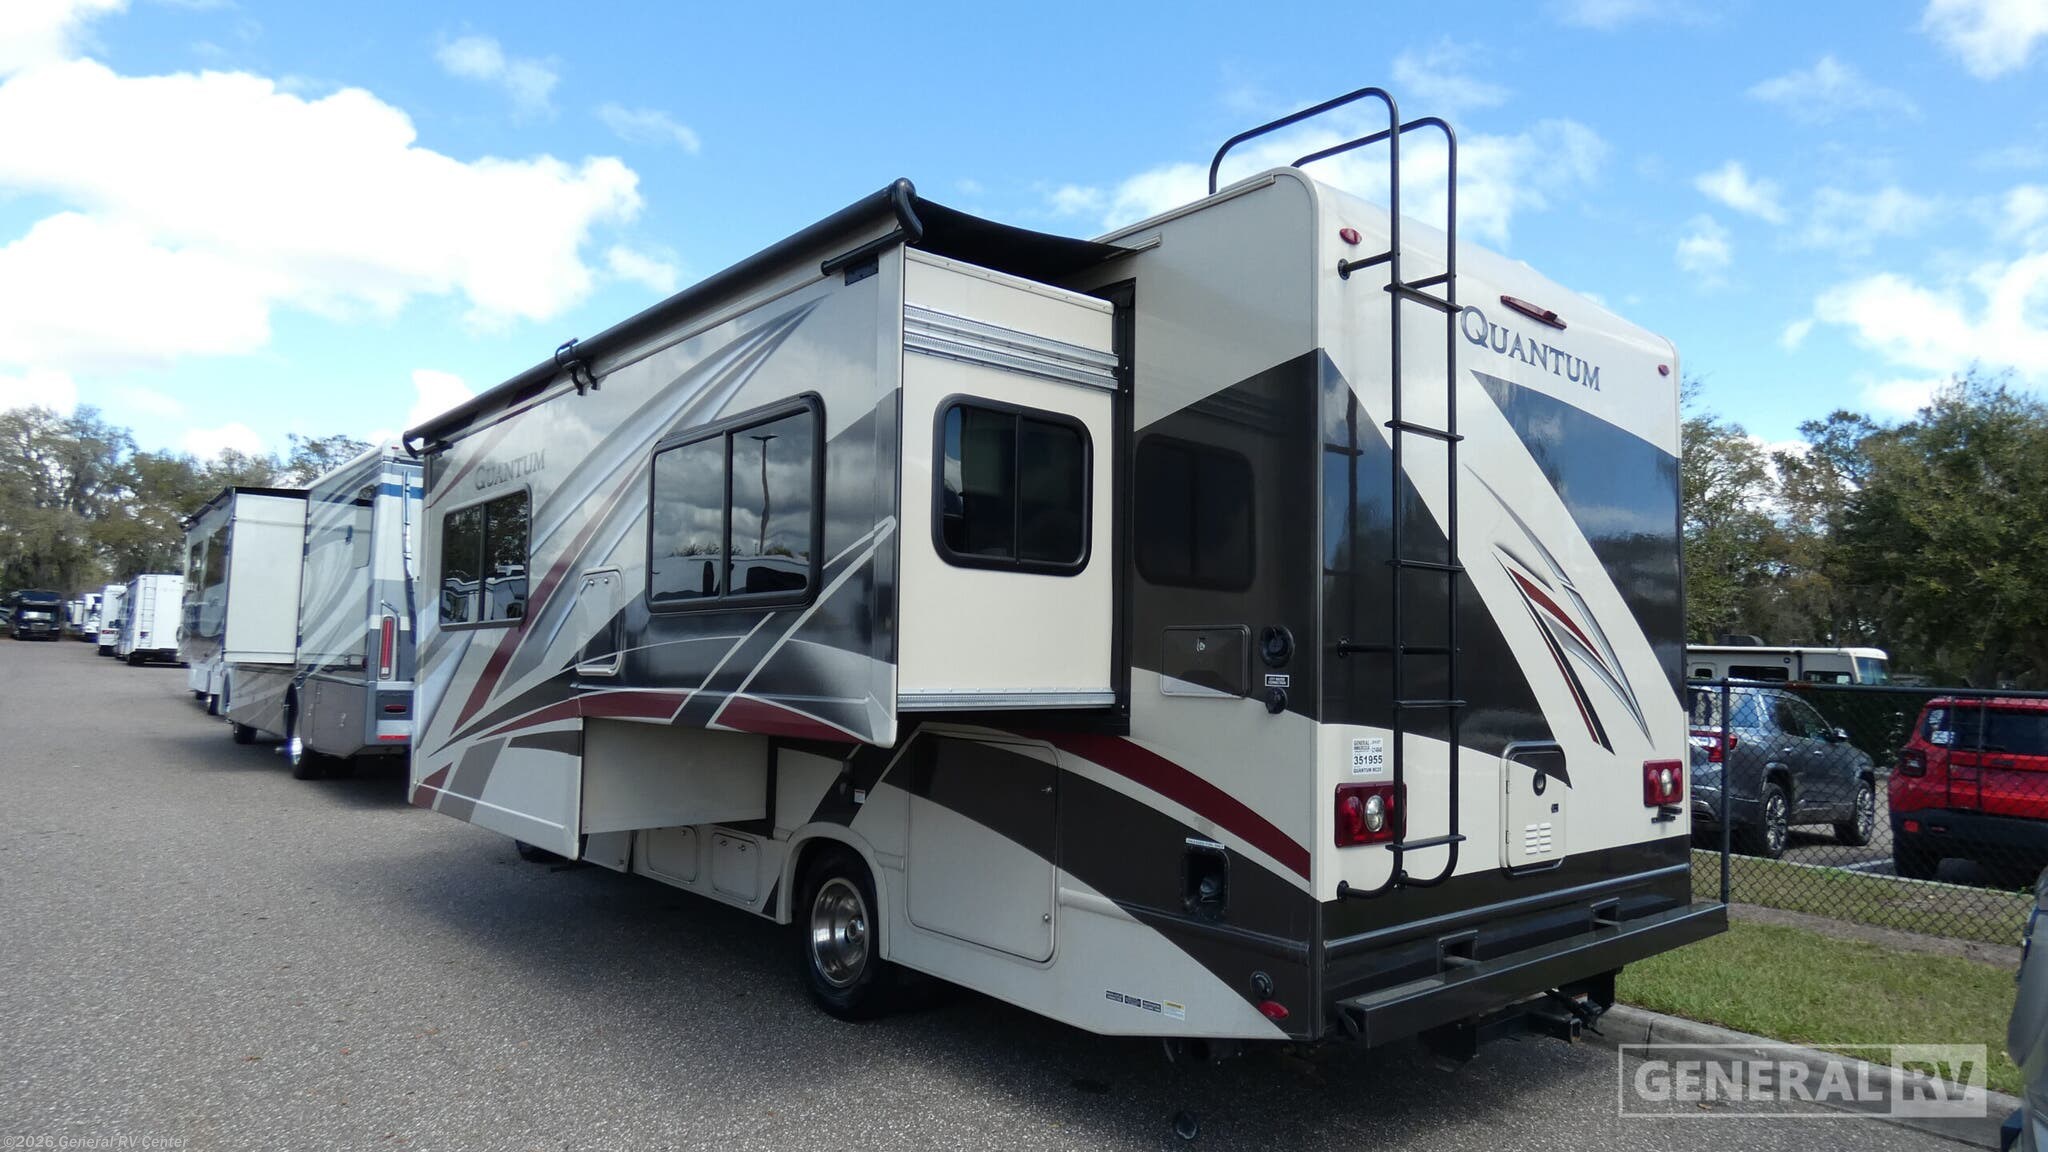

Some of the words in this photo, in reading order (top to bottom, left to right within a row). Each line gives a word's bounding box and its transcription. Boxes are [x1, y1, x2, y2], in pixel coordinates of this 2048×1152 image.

[1460, 305, 1601, 392] QUANTUM
[475, 448, 545, 490] QUANTUM
[1353, 754, 1383, 765] 351955
